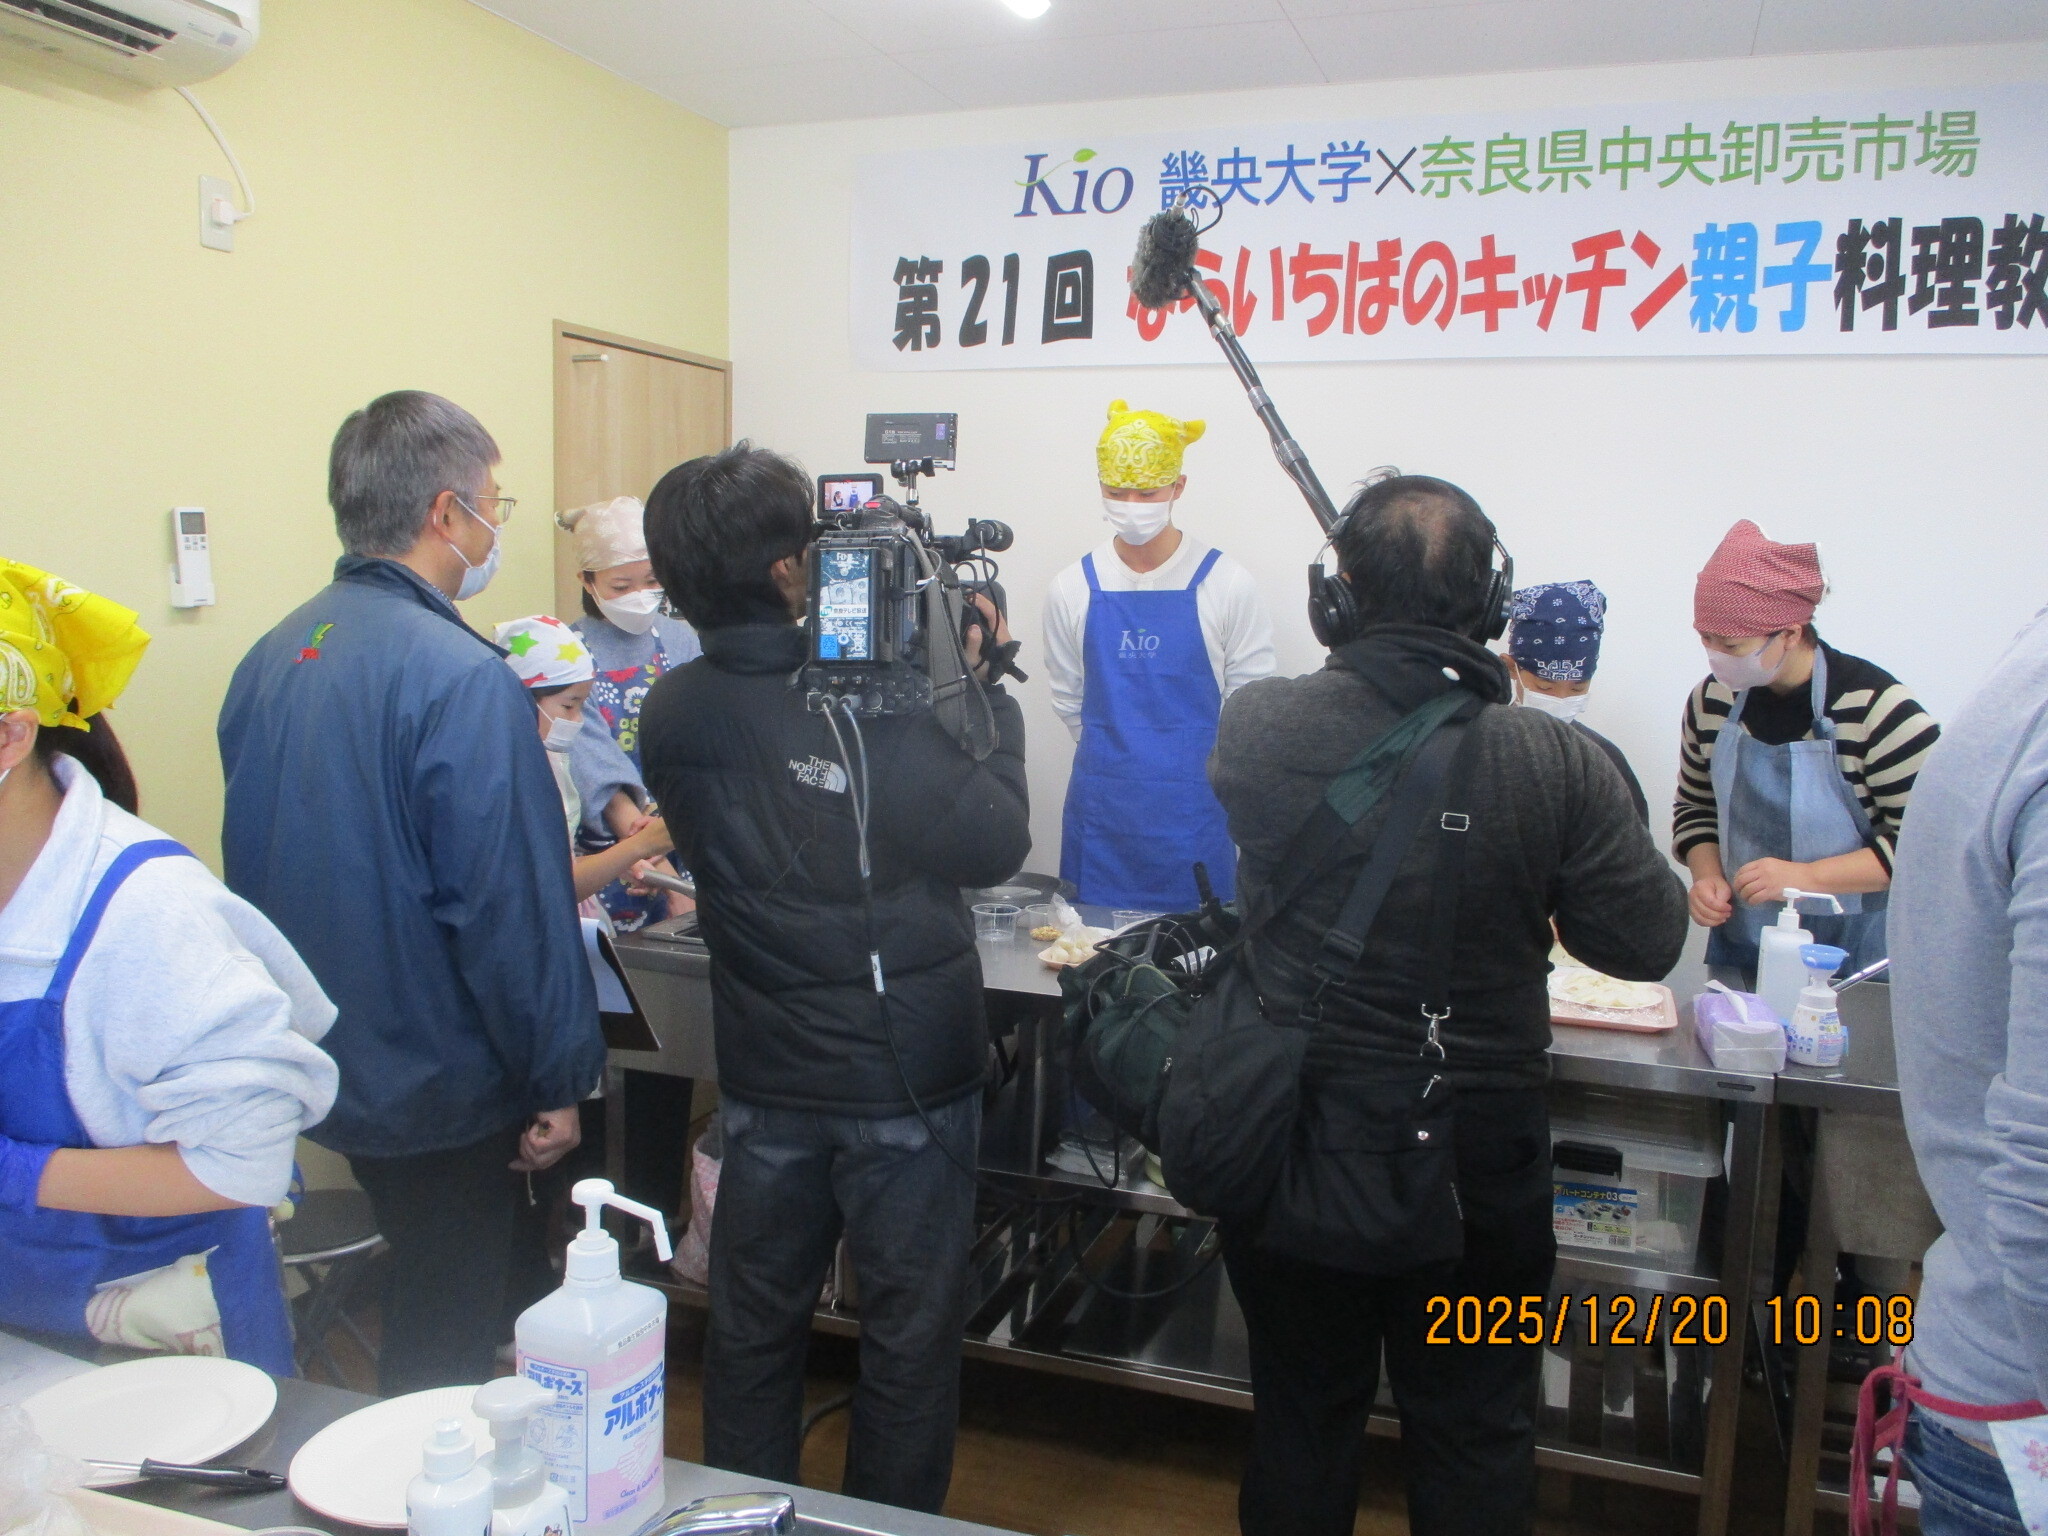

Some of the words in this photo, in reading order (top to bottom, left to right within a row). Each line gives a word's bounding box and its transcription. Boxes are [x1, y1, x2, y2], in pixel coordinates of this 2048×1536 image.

[1014, 149, 1134, 218] Kio
[891, 249, 1094, 352] 第21回
[1118, 629, 1160, 651] Kio
[788, 759, 828, 781] NORTH
[808, 755, 831, 771] THE
[796, 771, 825, 788] FACE
